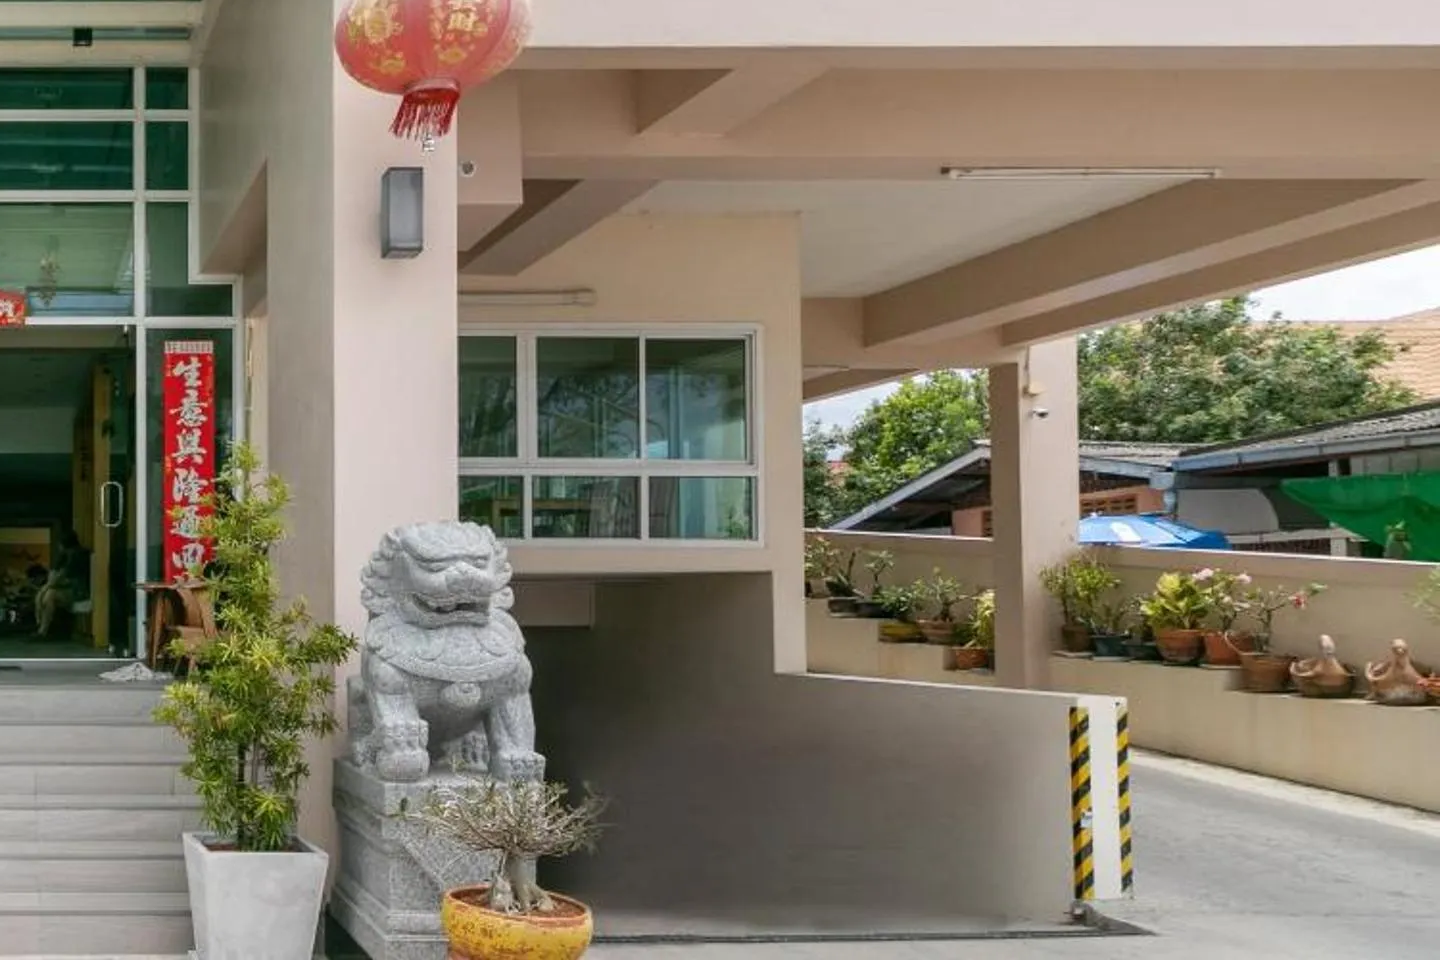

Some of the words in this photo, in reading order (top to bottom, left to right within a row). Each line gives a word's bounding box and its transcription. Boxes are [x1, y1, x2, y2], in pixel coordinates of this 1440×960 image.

[168, 355, 210, 584] 生意興隆通四
